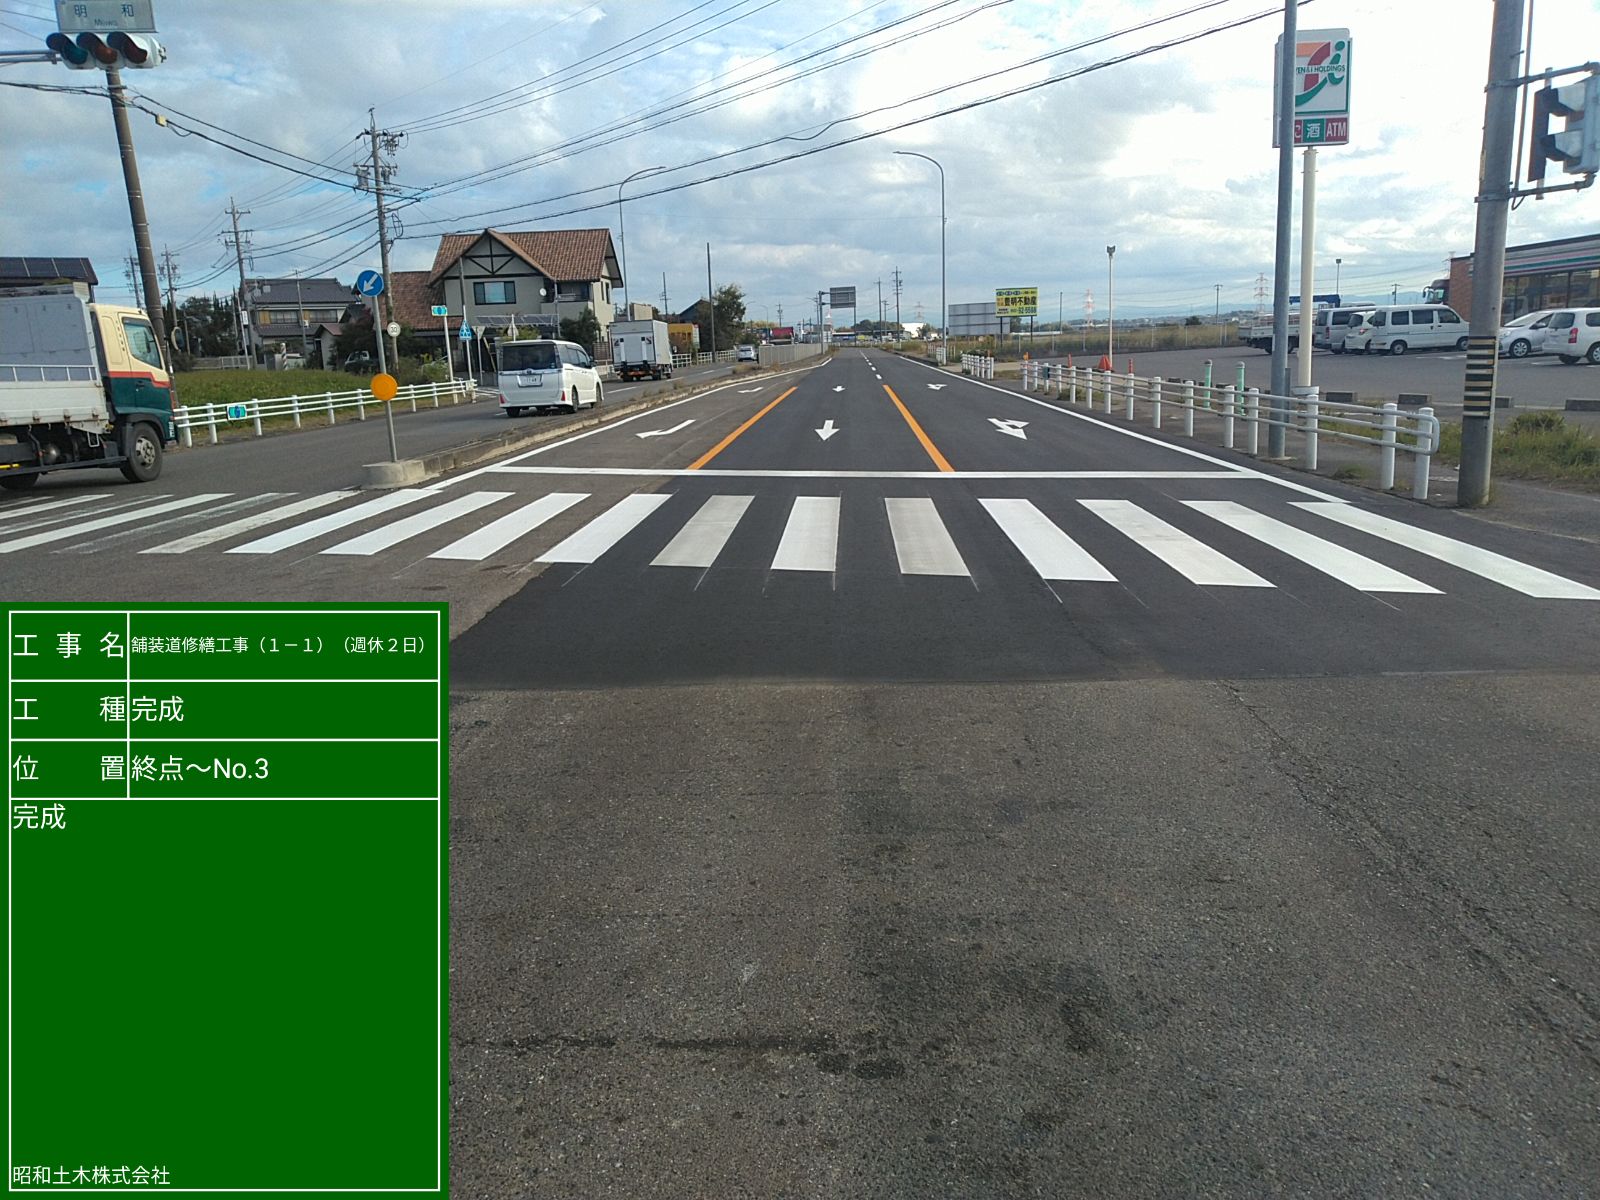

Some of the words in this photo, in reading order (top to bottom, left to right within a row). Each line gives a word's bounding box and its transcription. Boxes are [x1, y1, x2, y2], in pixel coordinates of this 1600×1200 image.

[1314, 65, 1345, 73] HOLDINGS
[1307, 123, 1321, 138] 酒
[1326, 122, 1346, 137] ATM
